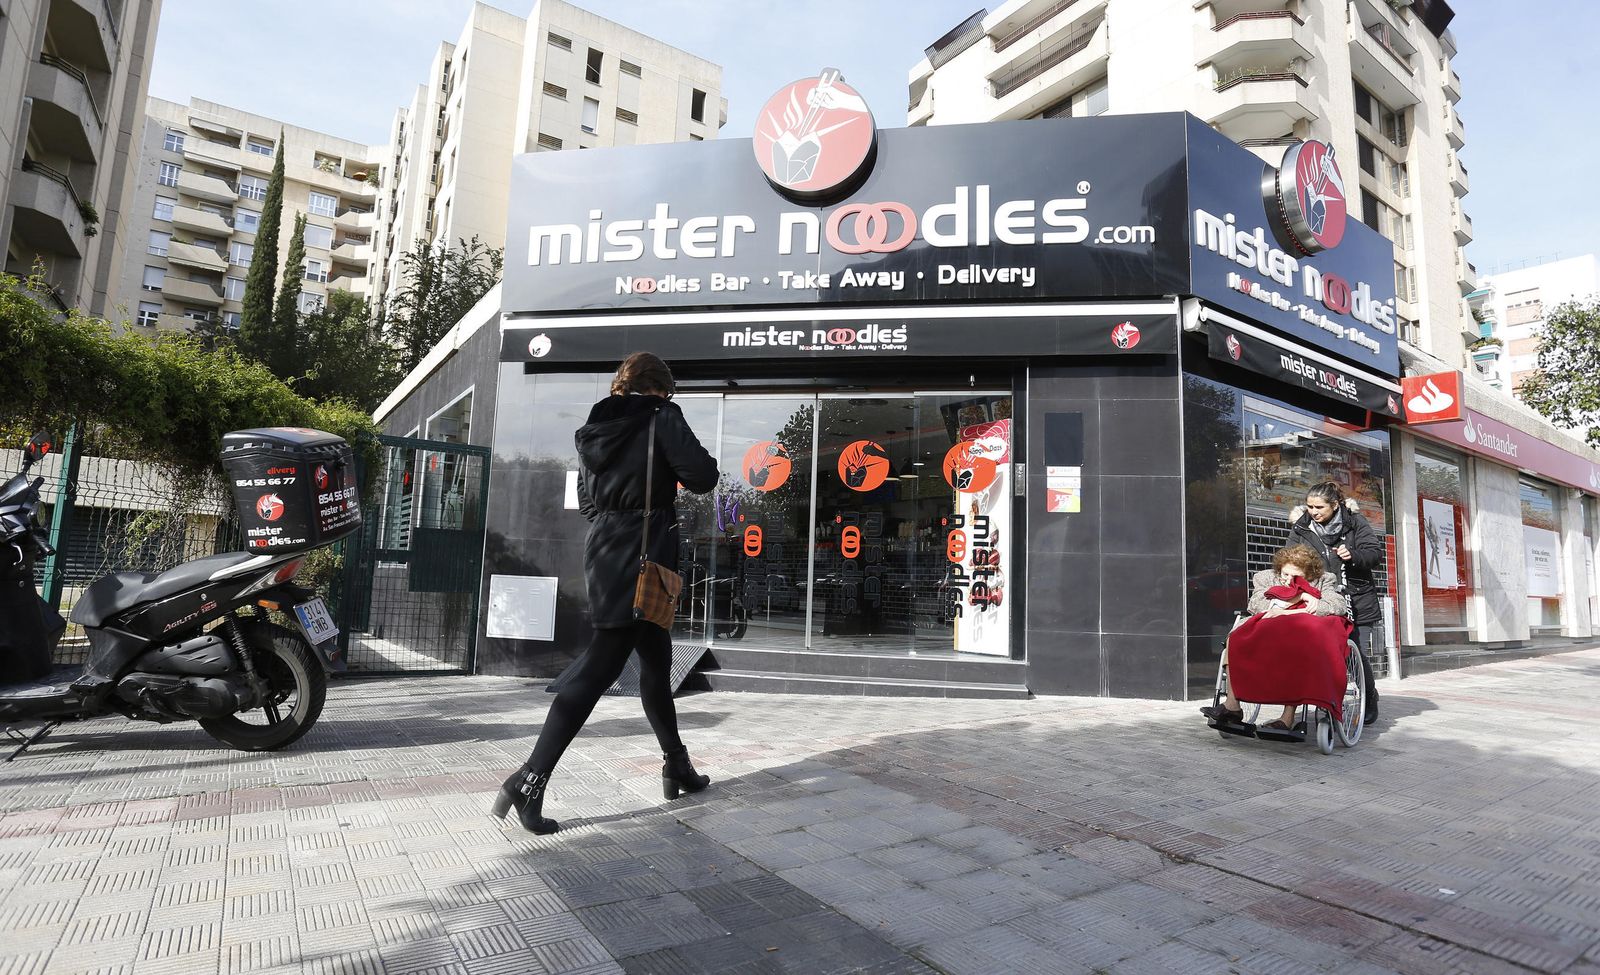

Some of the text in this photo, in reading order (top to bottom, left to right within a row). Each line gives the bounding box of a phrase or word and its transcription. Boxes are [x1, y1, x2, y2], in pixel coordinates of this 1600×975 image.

[527, 203, 756, 266] mister
[1194, 209, 1299, 287] mister
[615, 264, 1036, 295] Noodles Bar Take Away Delivery
[723, 324, 908, 346] mister noodles
[858, 343, 877, 352] Away
[1280, 354, 1317, 380] mister
[1319, 369, 1357, 396] noodles
[1477, 423, 1518, 458] Santander
[236, 479, 253, 487] 854
[254, 478, 267, 486] 55
[283, 477, 296, 485] 77
[318, 486, 355, 505] 854 55 66 77
[247, 526, 283, 537] mister
[946, 513, 971, 619] noodles
[972, 515, 996, 613] mister
[163, 610, 200, 633] AGILITY
[304, 601, 326, 620] 3141
[311, 616, 329, 635] GWB
